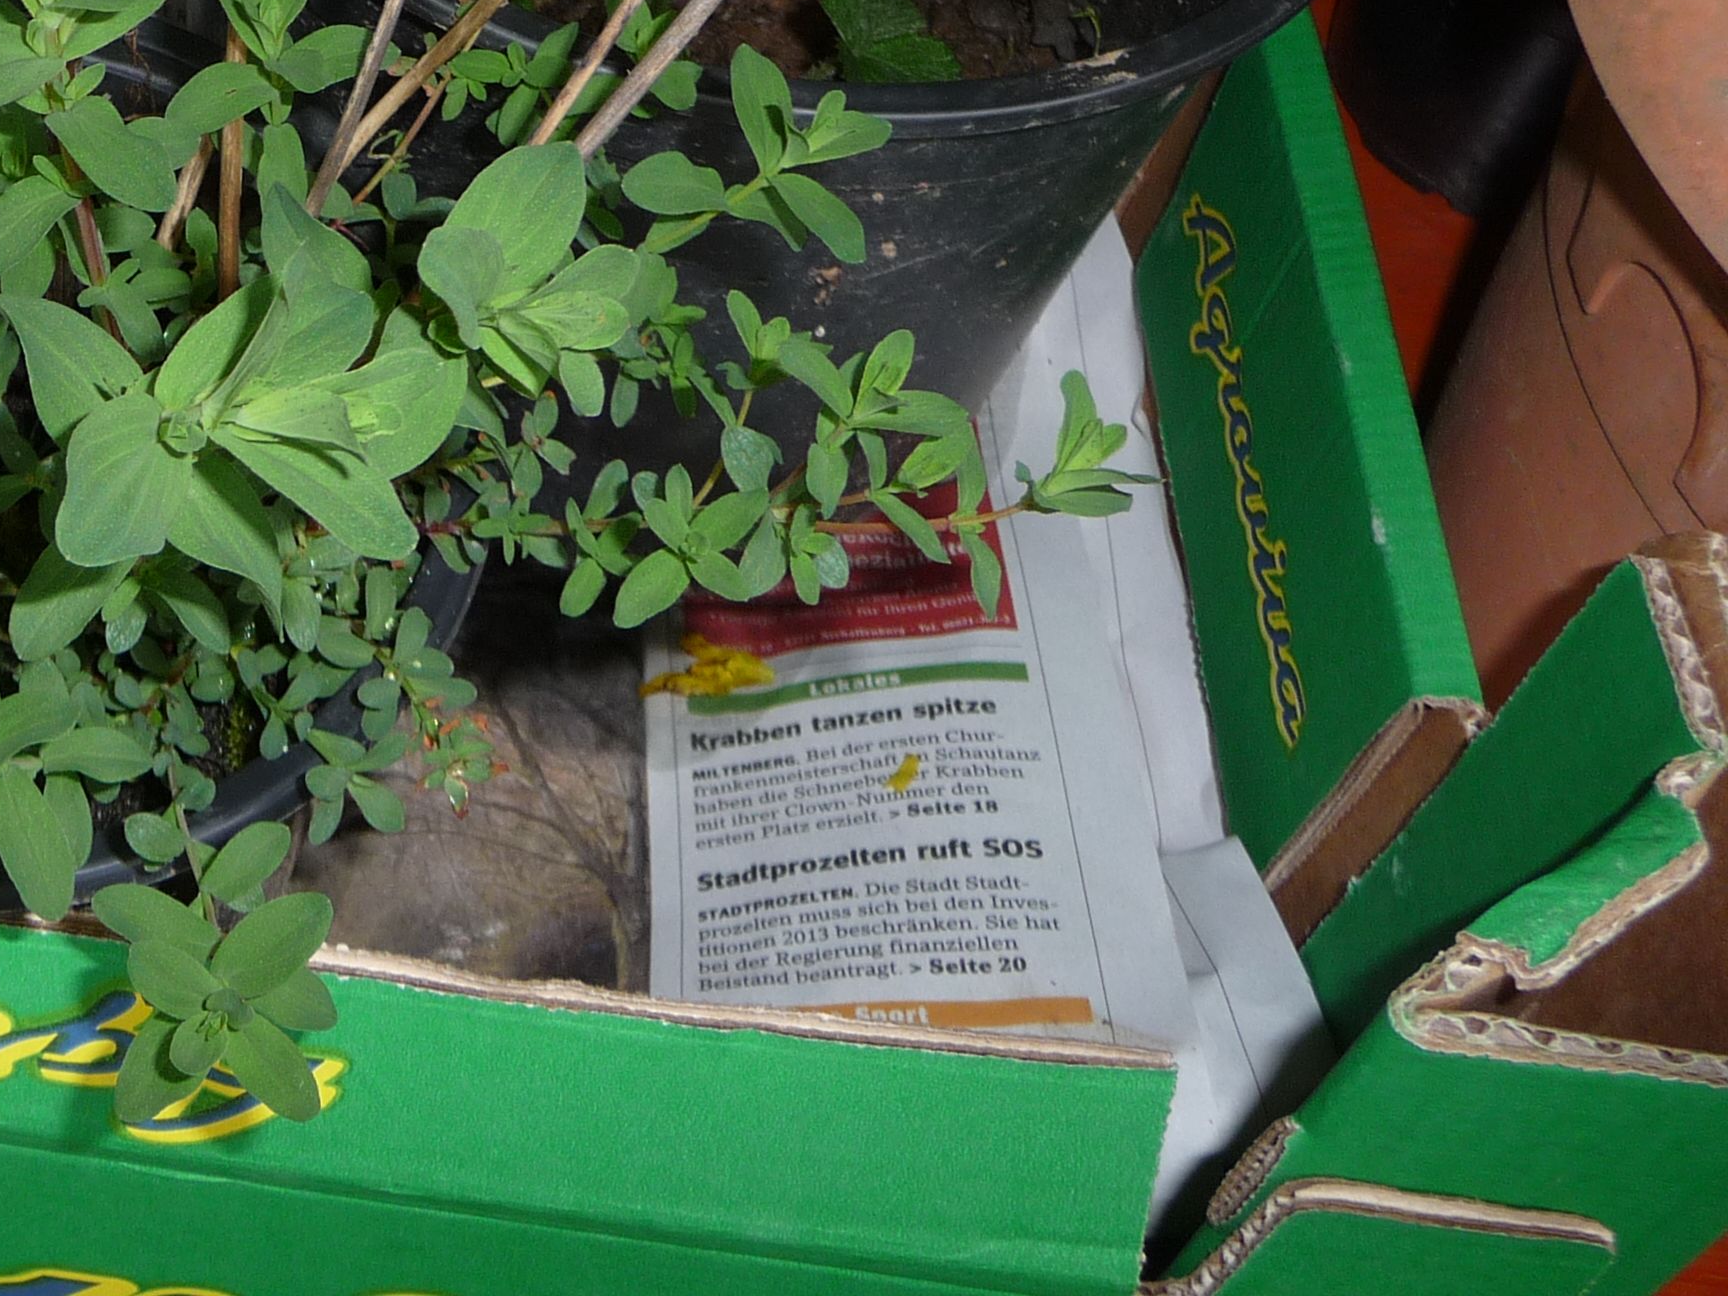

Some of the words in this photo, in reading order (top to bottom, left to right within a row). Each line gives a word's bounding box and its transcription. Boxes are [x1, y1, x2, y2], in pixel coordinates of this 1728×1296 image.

[1183, 194, 1307, 749] Agroviva
[809, 671, 901, 697] Lokales
[690, 723, 802, 752] Krabben
[812, 707, 903, 734] tanzen
[913, 696, 998, 722] spitze
[692, 754, 801, 783] MILTENBERG.
[805, 745, 838, 764] Bei
[841, 742, 875, 758] der
[877, 732, 941, 751] ersten
[693, 753, 899, 799] frankenmeisterschaft
[934, 745, 1042, 763] Schautanz
[694, 795, 754, 816] haben
[759, 789, 789, 806] die
[793, 765, 929, 800] Schneeber
[934, 765, 1025, 781] Krabben
[694, 817, 726, 834] mit
[731, 810, 779, 827] ihrer
[952, 782, 990, 797] den
[694, 830, 755, 851] ersten
[760, 822, 810, 840] Platz
[907, 802, 967, 819] Seite
[974, 799, 1000, 815] 18
[696, 845, 907, 893] Stadtprozelten
[917, 837, 974, 864] ruft
[981, 837, 1045, 860] SOS
[697, 885, 860, 924] STADTPROZELTEN.
[865, 882, 901, 898] Die
[905, 877, 962, 895] Stadt
[966, 874, 1030, 892] Stadt-
[698, 914, 793, 944] prozelten
[799, 906, 852, 924] muss
[858, 900, 900, 918] sich
[905, 898, 939, 915] bei
[944, 895, 985, 912] den
[991, 893, 1057, 912] Inves-
[698, 935, 777, 959] titionen
[782, 926, 829, 947] 2013
[834, 916, 980, 940] beschränken.
[985, 913, 1019, 931] Sie
[1024, 914, 1061, 932] hat
[698, 959, 729, 976] bei
[733, 955, 770, 972] der
[776, 942, 884, 968] Regierung
[889, 935, 1019, 956] finanziellen
[698, 970, 790, 994] Beistand
[795, 959, 904, 986] beantragt.
[928, 956, 994, 975] Seite
[998, 955, 1028, 974] 20
